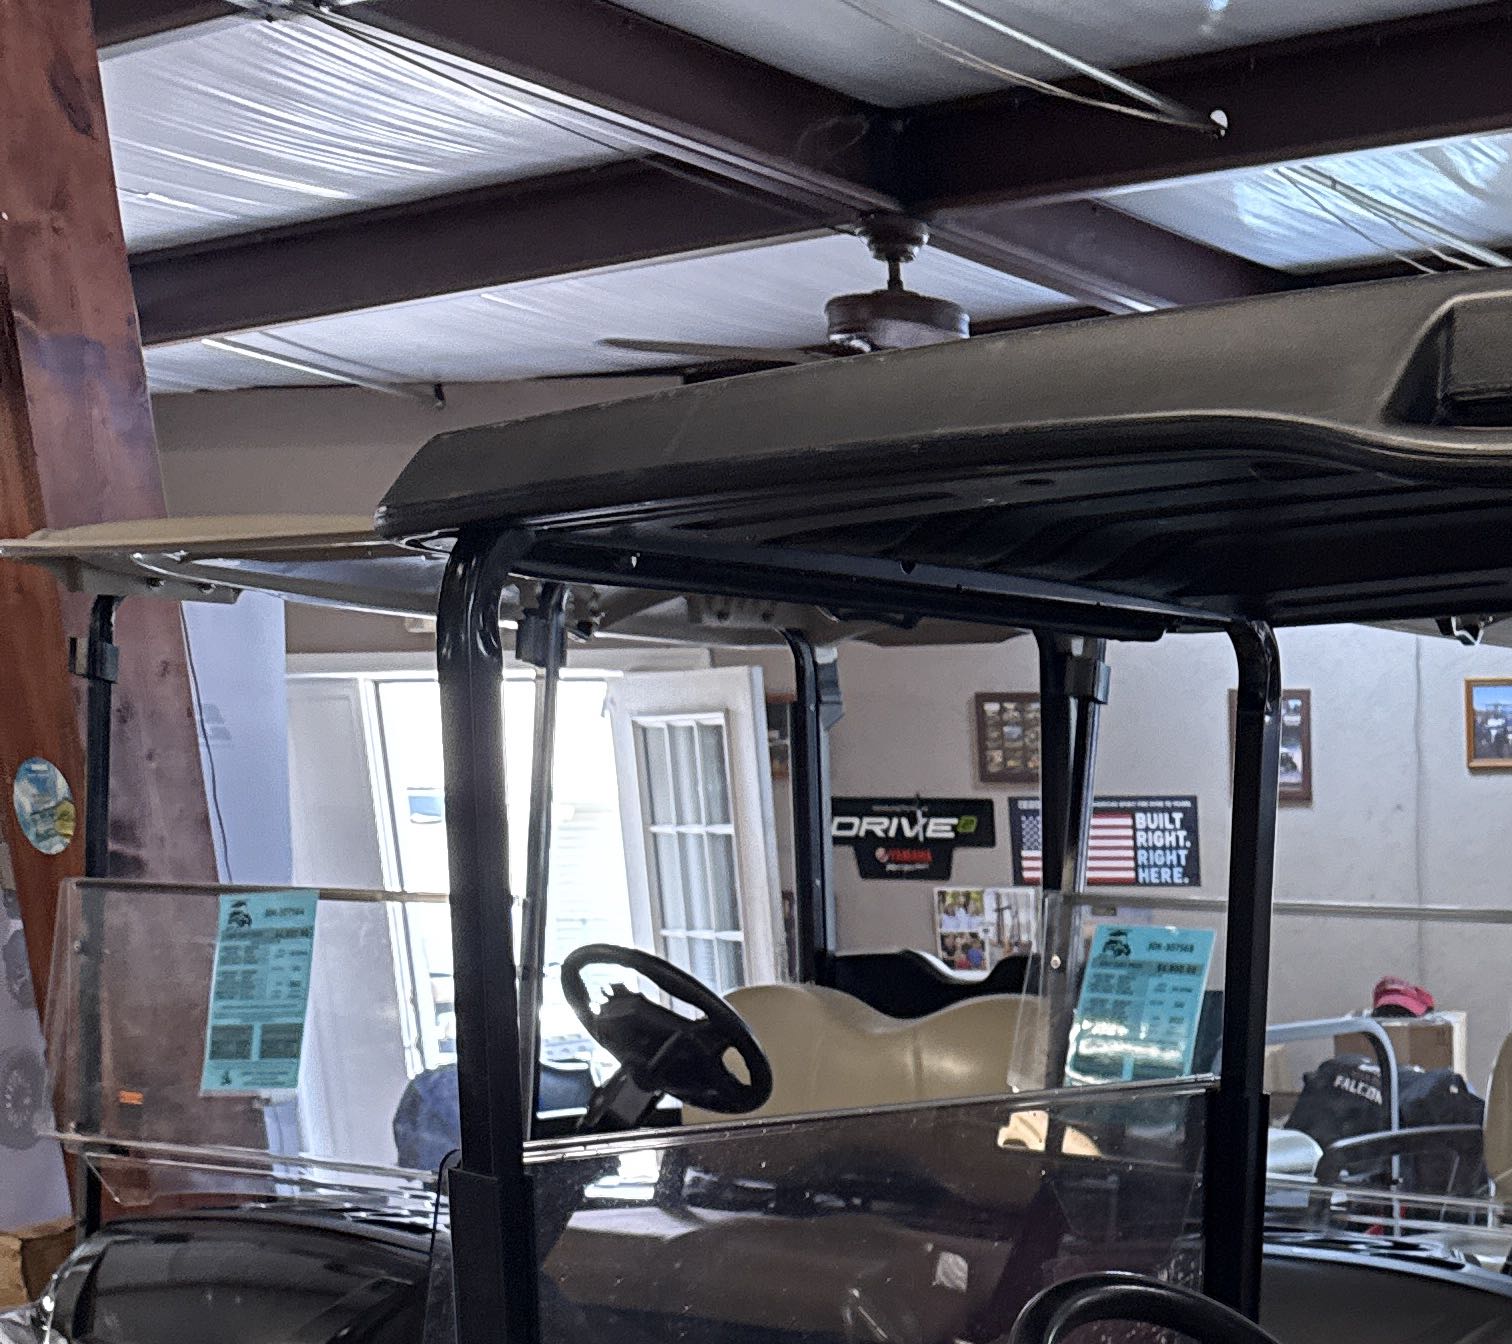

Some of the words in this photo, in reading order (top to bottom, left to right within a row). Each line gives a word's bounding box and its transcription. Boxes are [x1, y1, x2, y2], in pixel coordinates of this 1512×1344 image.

[1135, 812, 1184, 830] BUILT
[1136, 830, 1192, 849] RIGHT.
[1137, 849, 1189, 867] RIGHT
[1138, 866, 1190, 884] HERE.
